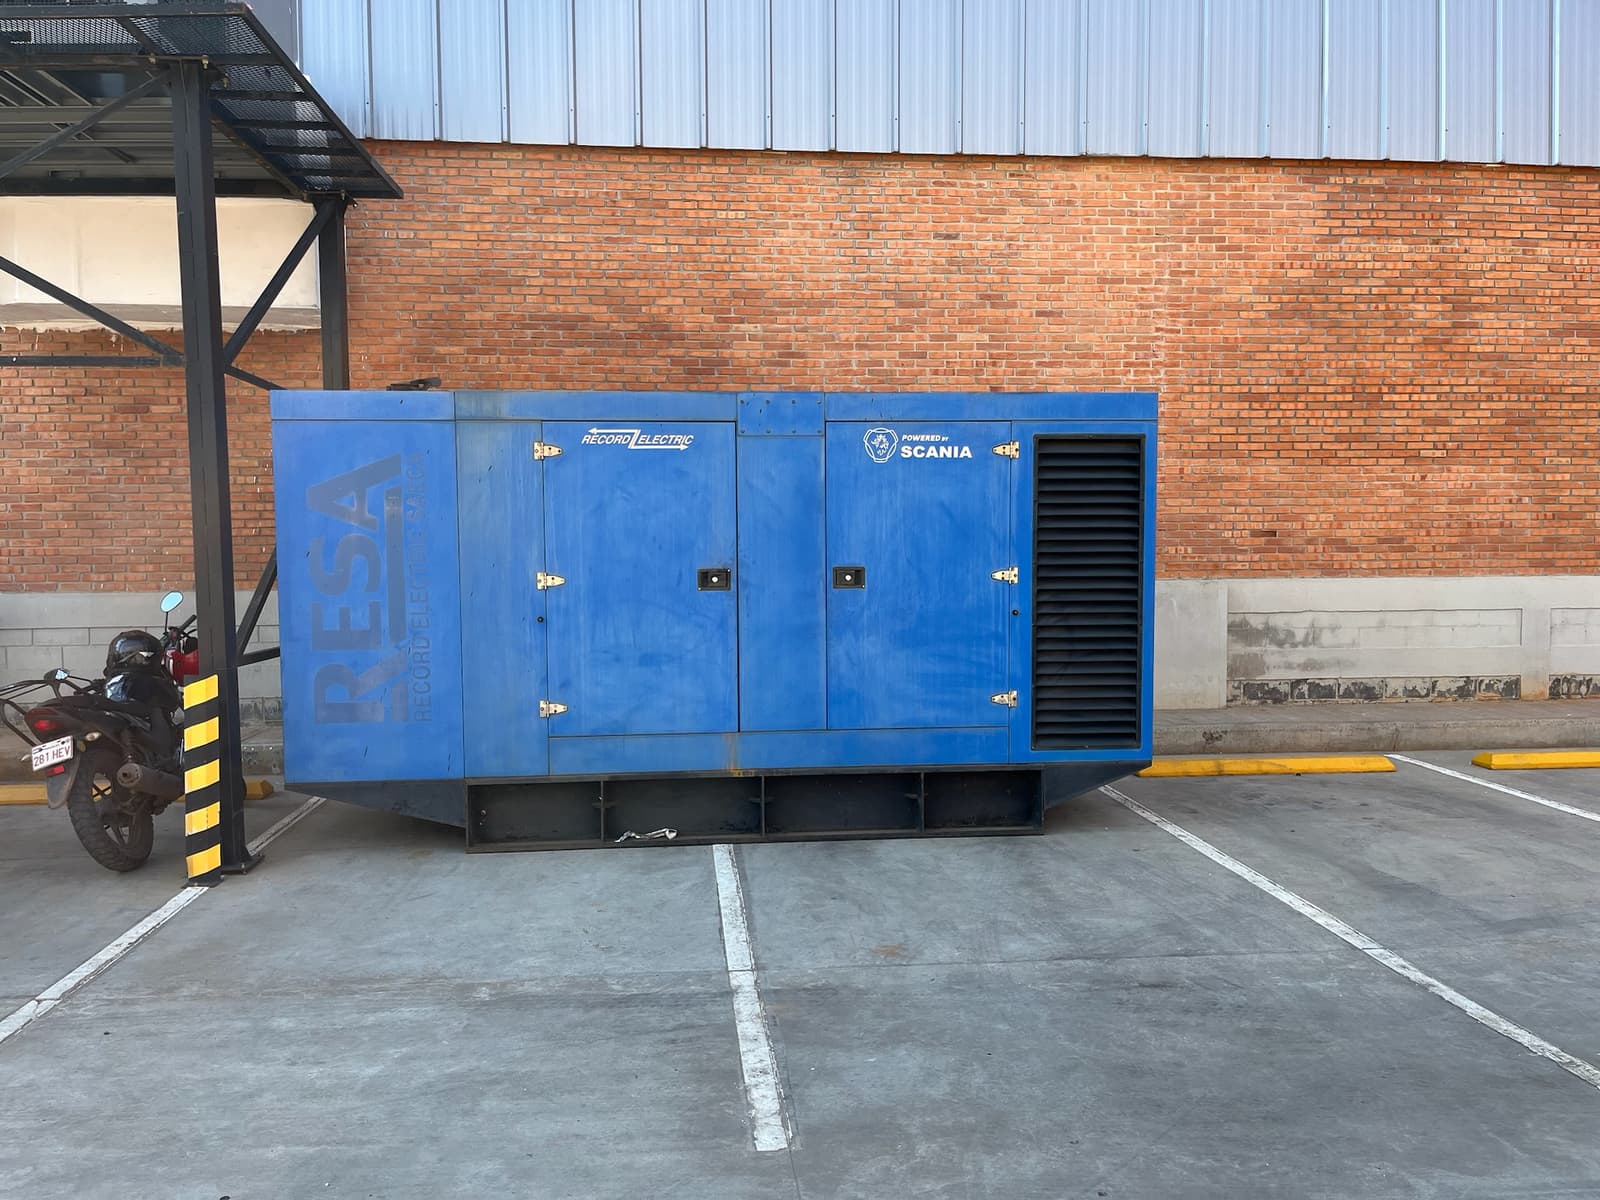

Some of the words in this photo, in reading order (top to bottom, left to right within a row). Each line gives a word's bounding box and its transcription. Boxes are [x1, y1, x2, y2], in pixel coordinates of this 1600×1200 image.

[582, 434, 630, 445] RECORD
[637, 434, 695, 445] ELECTRIC
[900, 445, 973, 459] SCANIA
[307, 453, 407, 724] RESA
[412, 636, 433, 722] RECORD
[34, 753, 49, 766] 281
[52, 746, 70, 760] HEV
